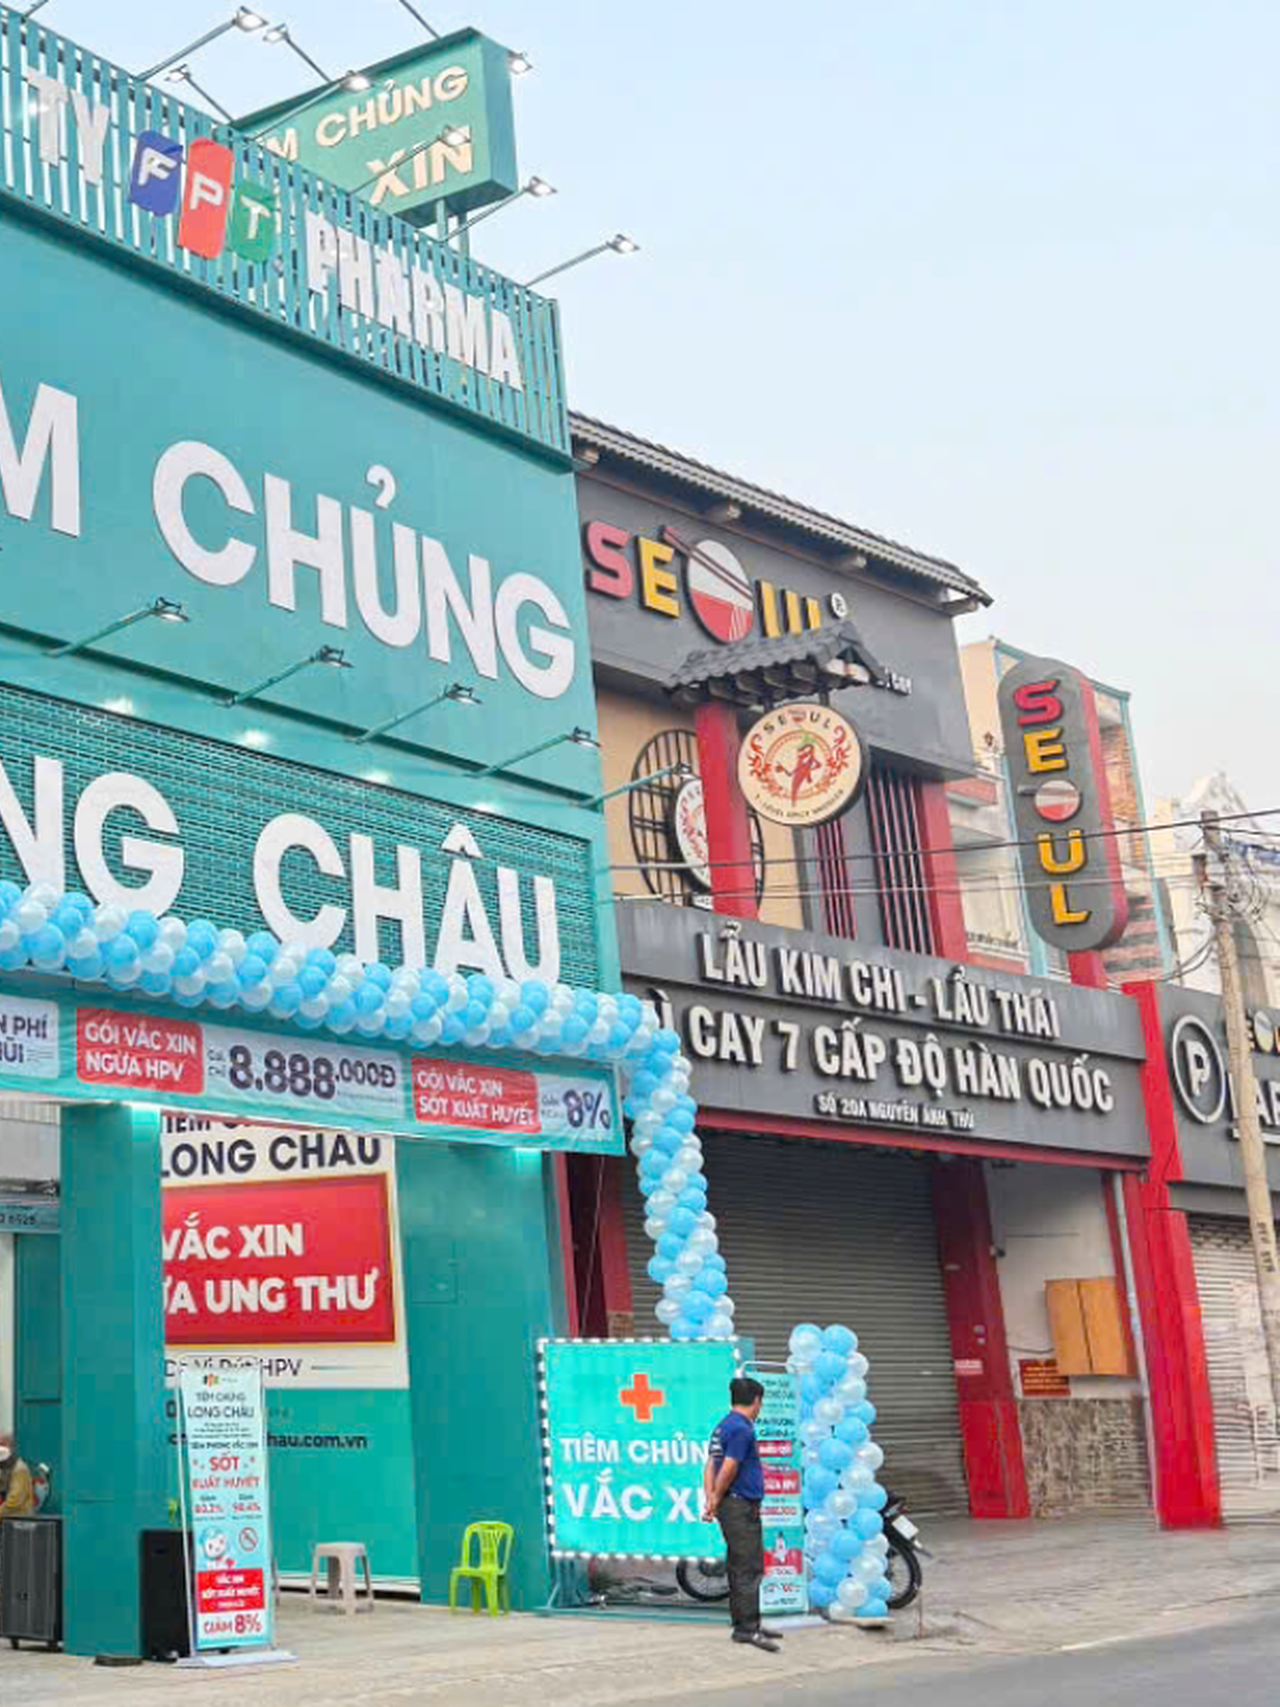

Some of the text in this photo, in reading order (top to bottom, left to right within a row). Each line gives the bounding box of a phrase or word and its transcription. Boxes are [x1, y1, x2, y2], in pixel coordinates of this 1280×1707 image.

[316, 65, 468, 148] CHỦNG
[367, 124, 474, 206] XIN
[26, 65, 524, 393] TY FPT PHARMA
[152, 440, 576, 699] CHỦNG
[253, 824, 561, 985] CHÂU
[698, 920, 767, 989] LẨU
[776, 946, 843, 1003] KIM
[850, 965, 909, 1014] CHI
[932, 965, 991, 1029] LẨU
[994, 988, 1062, 1039] THÁI
[13, 1013, 50, 1040] PHÍ
[84, 1019, 197, 1057] GÓI VẮC XIN
[146, 1058, 184, 1083] HPV
[687, 1004, 1116, 1114] CAY 7 CẤP ĐỘ HÀN QUỐC
[1183, 1039, 1212, 1098] P
[479, 1078, 504, 1099] XIN
[563, 1088, 612, 1131] 8%
[161, 1140, 257, 1178] ONG
[162, 1211, 304, 1261] VẮC XIN
[204, 1277, 286, 1315] UNG
[293, 1266, 380, 1312] THƯ
[187, 1406, 221, 1419] LONG
[560, 1431, 620, 1464] TIÊM
[562, 1467, 654, 1521] VẮC
[234, 1612, 264, 1636] 8%
